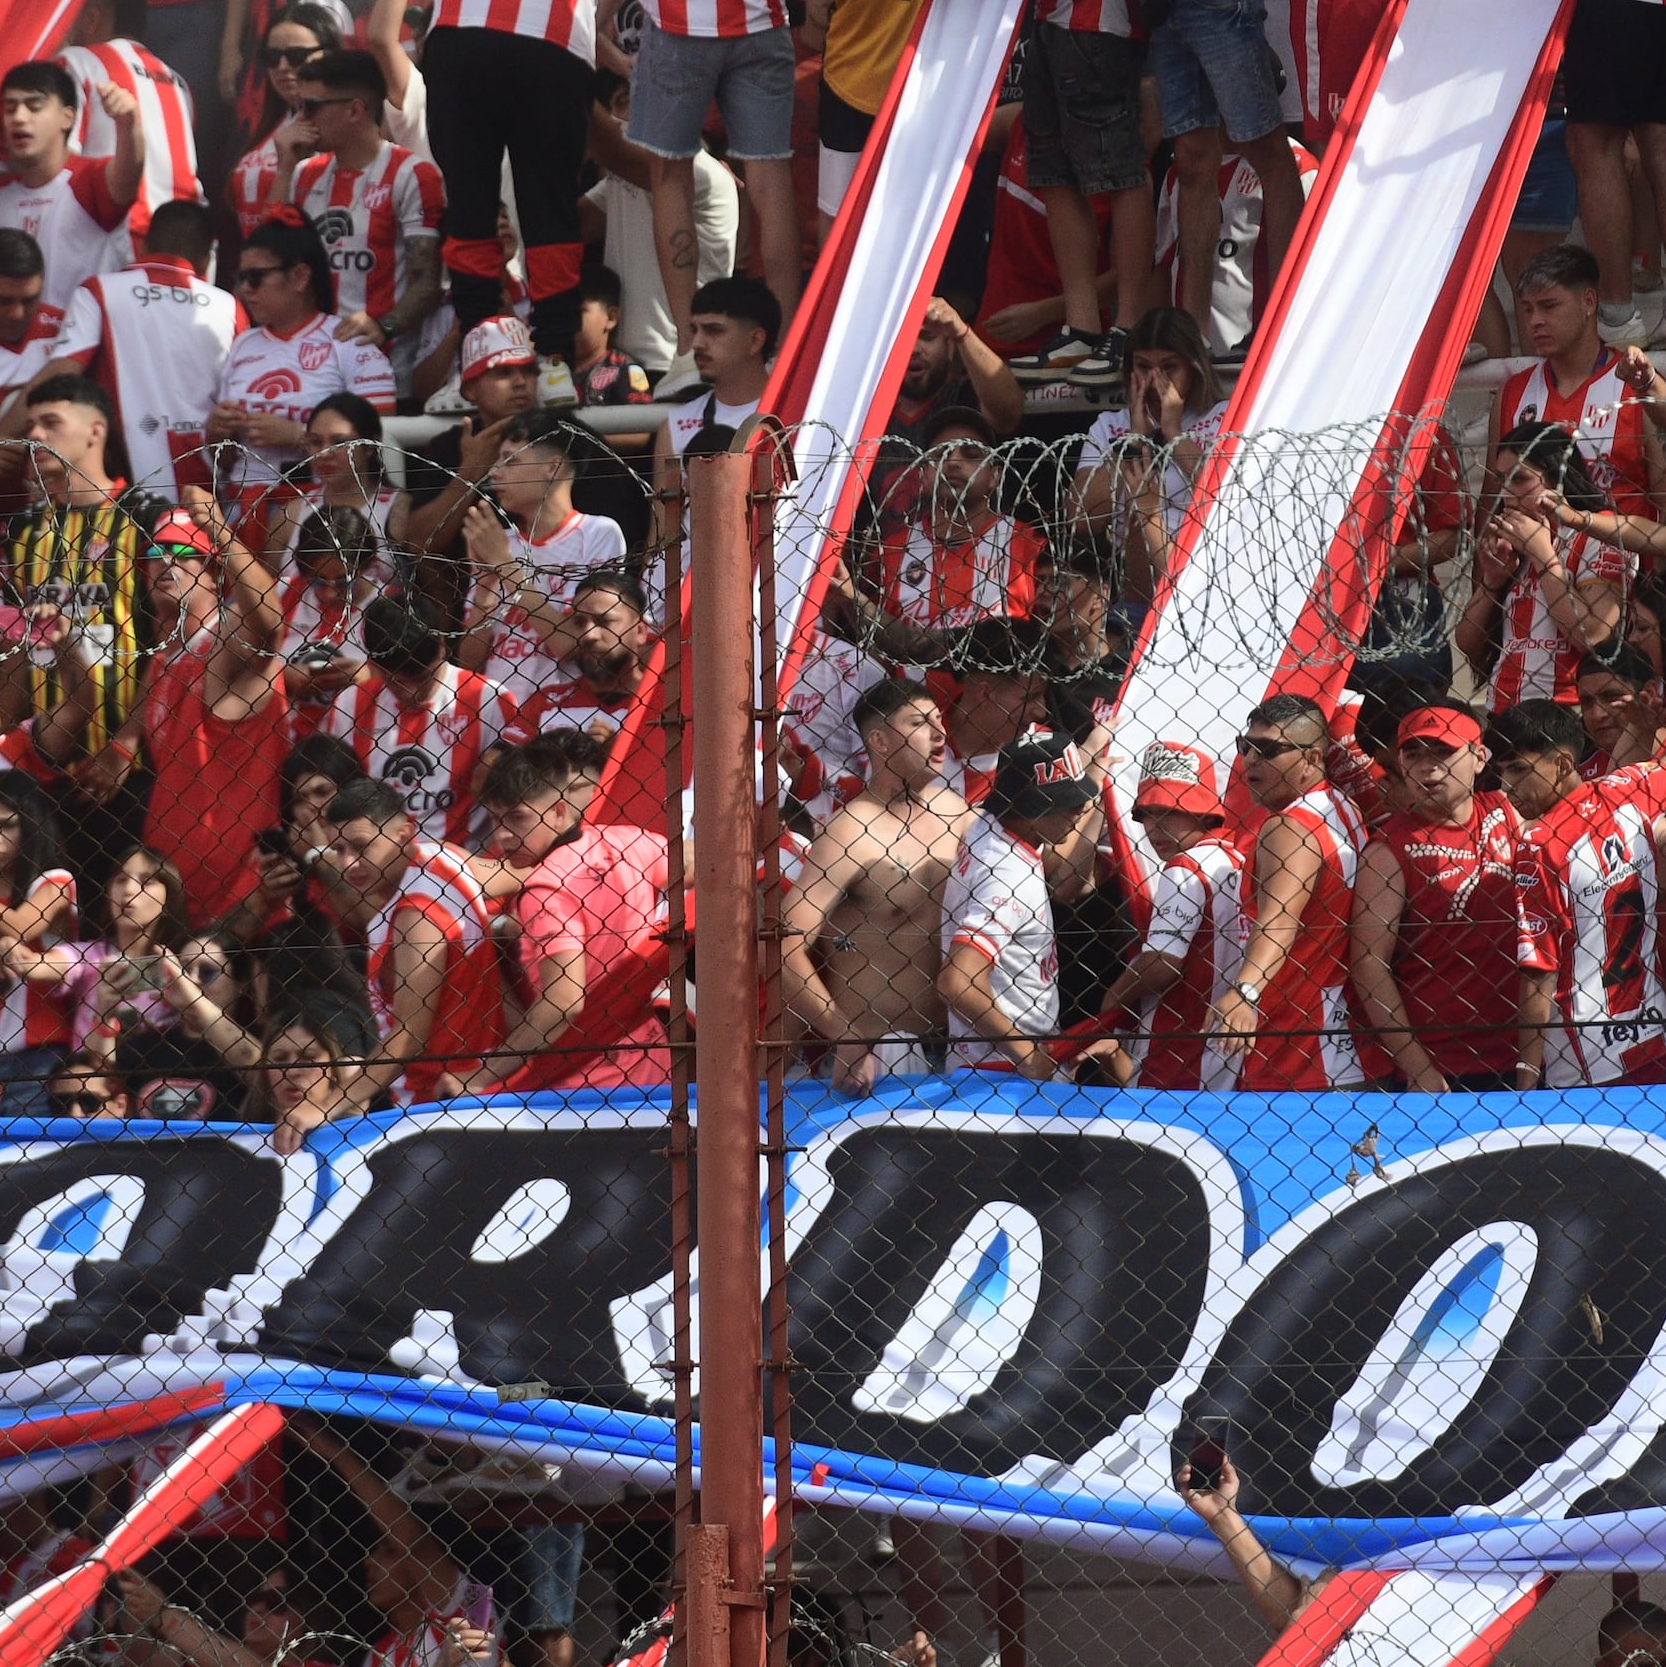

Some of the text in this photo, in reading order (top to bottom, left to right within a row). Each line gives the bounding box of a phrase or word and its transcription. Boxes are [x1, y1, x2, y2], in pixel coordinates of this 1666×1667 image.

[328, 249, 375, 272] cro
[407, 790, 454, 813] cro
[1604, 890, 1644, 988] 2
